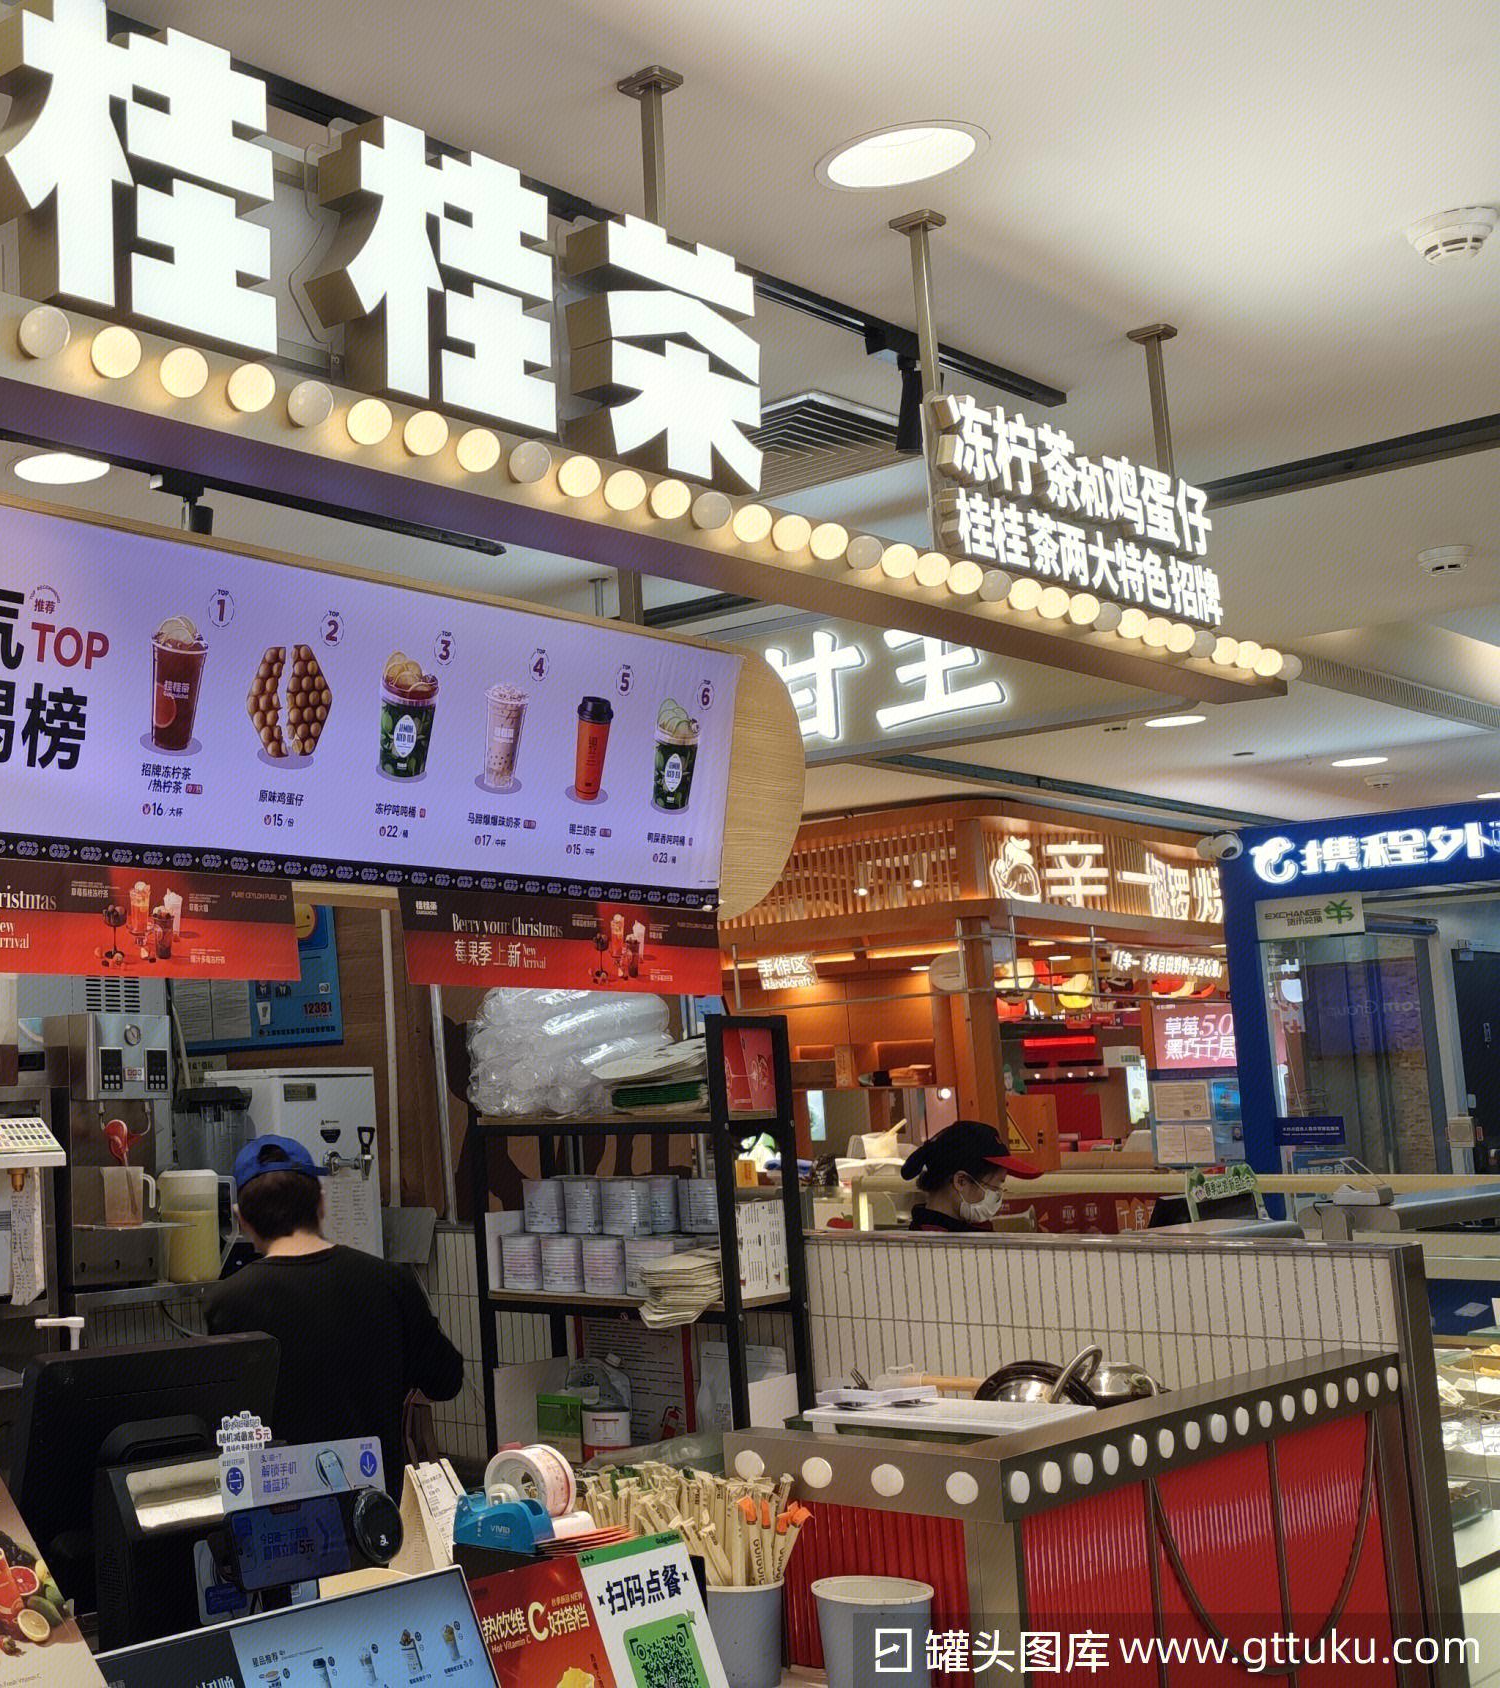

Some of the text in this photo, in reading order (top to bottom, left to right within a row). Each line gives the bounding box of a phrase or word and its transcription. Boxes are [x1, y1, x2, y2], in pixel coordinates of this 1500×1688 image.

[5, 0, 763, 492] 桂桂茶
[953, 396, 1212, 556] 冻柠茶和鸡蛋仔
[957, 494, 1223, 626] 桂桂茶两大特色招牌
[217, 589, 229, 597] TOP
[33, 598, 56, 614] 推荐
[216, 599, 226, 622] 1
[325, 620, 339, 642] 2
[31, 622, 110, 669] TOP
[439, 639, 451, 661] 3
[533, 657, 545, 677] 4
[620, 672, 630, 692] 5
[700, 687, 711, 707] 6
[141, 762, 191, 780] 招牌冻柠茶
[258, 789, 304, 807] 原味鸡蛋仔
[1264, 907, 1322, 921] EXCHANGE
[452, 913, 481, 938] Berry
[483, 918, 510, 939] your
[512, 916, 564, 938] Christmas
[454, 938, 521, 968] 莓果季上新
[1165, 1035, 1237, 1060] 黑巧千层
[261, 1461, 298, 1478] 解锁手机
[606, 1563, 682, 1616] 扫码点餐
[482, 1601, 591, 1644] 热饮维 C 好搭档
